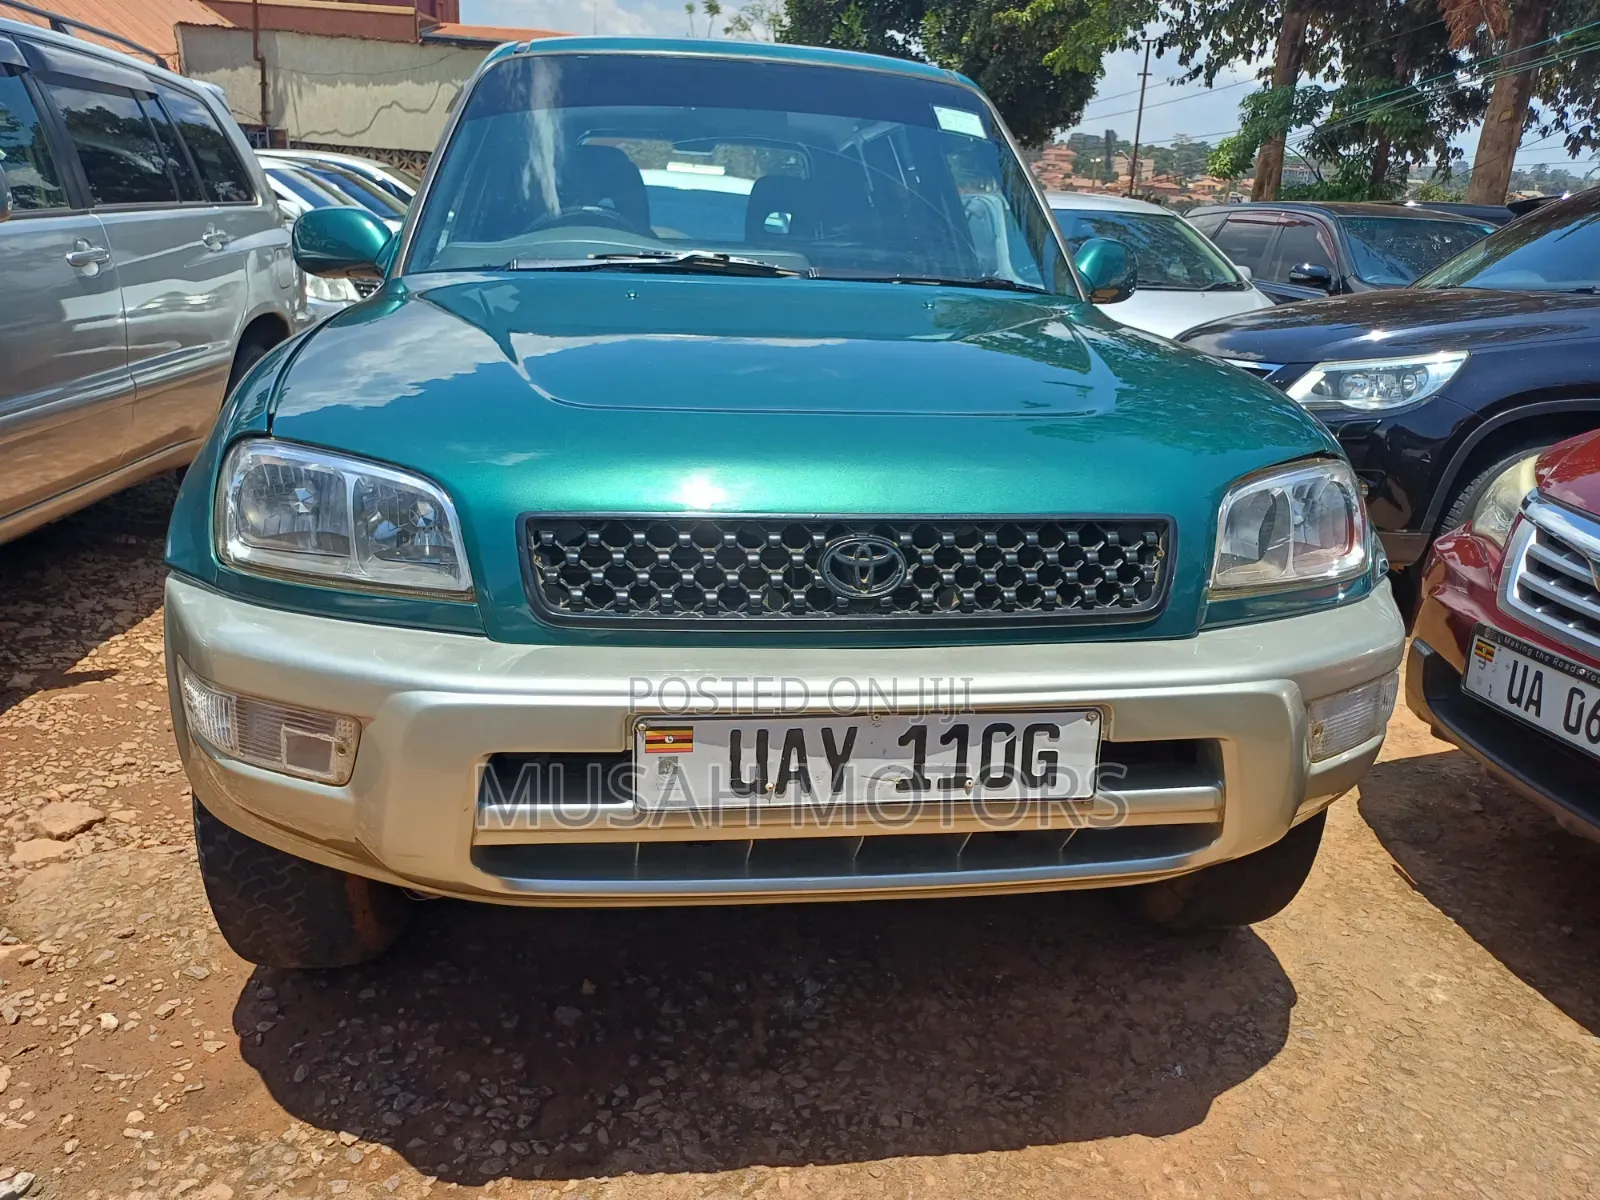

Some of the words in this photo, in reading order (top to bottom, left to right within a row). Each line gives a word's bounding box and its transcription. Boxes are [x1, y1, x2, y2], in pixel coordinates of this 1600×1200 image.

[1503, 637, 1532, 655] Making
[1535, 650, 1550, 662] the
[1506, 660, 1544, 718] UA
[729, 727, 858, 797] UAY
[897, 723, 1061, 794] 110G
